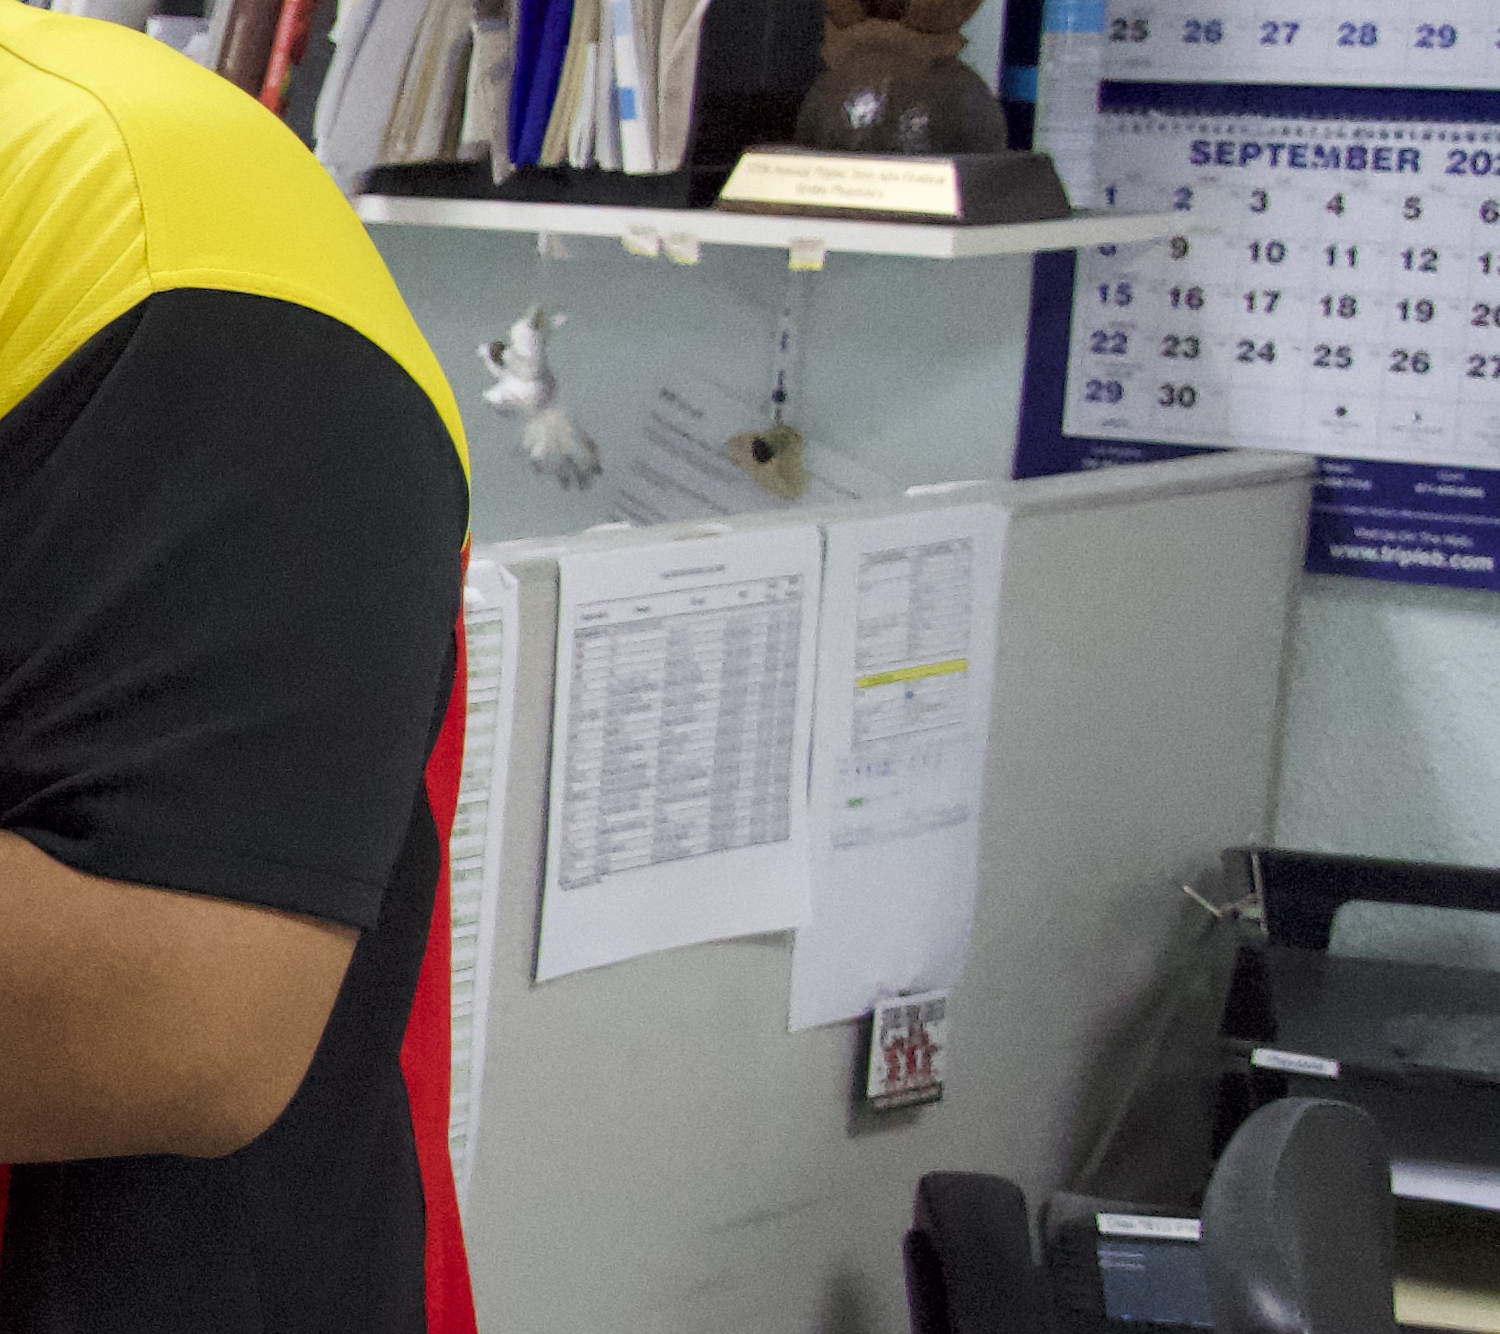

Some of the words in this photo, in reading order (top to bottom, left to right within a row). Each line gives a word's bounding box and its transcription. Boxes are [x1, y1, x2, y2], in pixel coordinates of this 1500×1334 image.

[1109, 18, 1150, 44] 25
[1182, 19, 1223, 45] 26
[1260, 21, 1300, 46] 27
[1338, 22, 1378, 47] 28
[1414, 23, 1458, 49] 29
[1190, 140, 1421, 173] SEPTEMBER
[1105, 185, 1117, 205] 1
[1173, 186, 1194, 211] 2
[1250, 189, 1269, 214] 3
[1326, 193, 1345, 217] 4
[1403, 196, 1422, 220] 5
[1170, 235, 1190, 260] 9
[1249, 240, 1287, 265] 10
[1325, 245, 1359, 268] 11
[1402, 247, 1439, 273] 12
[1099, 282, 1133, 308] 15
[1170, 286, 1205, 311] 16
[1244, 290, 1281, 313] 17
[1320, 294, 1358, 319] 18
[1398, 298, 1435, 323] 19
[1090, 330, 1128, 356] 22
[1162, 334, 1199, 359] 23
[1237, 339, 1276, 363] 24
[1313, 344, 1353, 368] 25
[1389, 348, 1430, 374] 26
[1085, 379, 1124, 404] 29
[1158, 382, 1197, 408] 30
